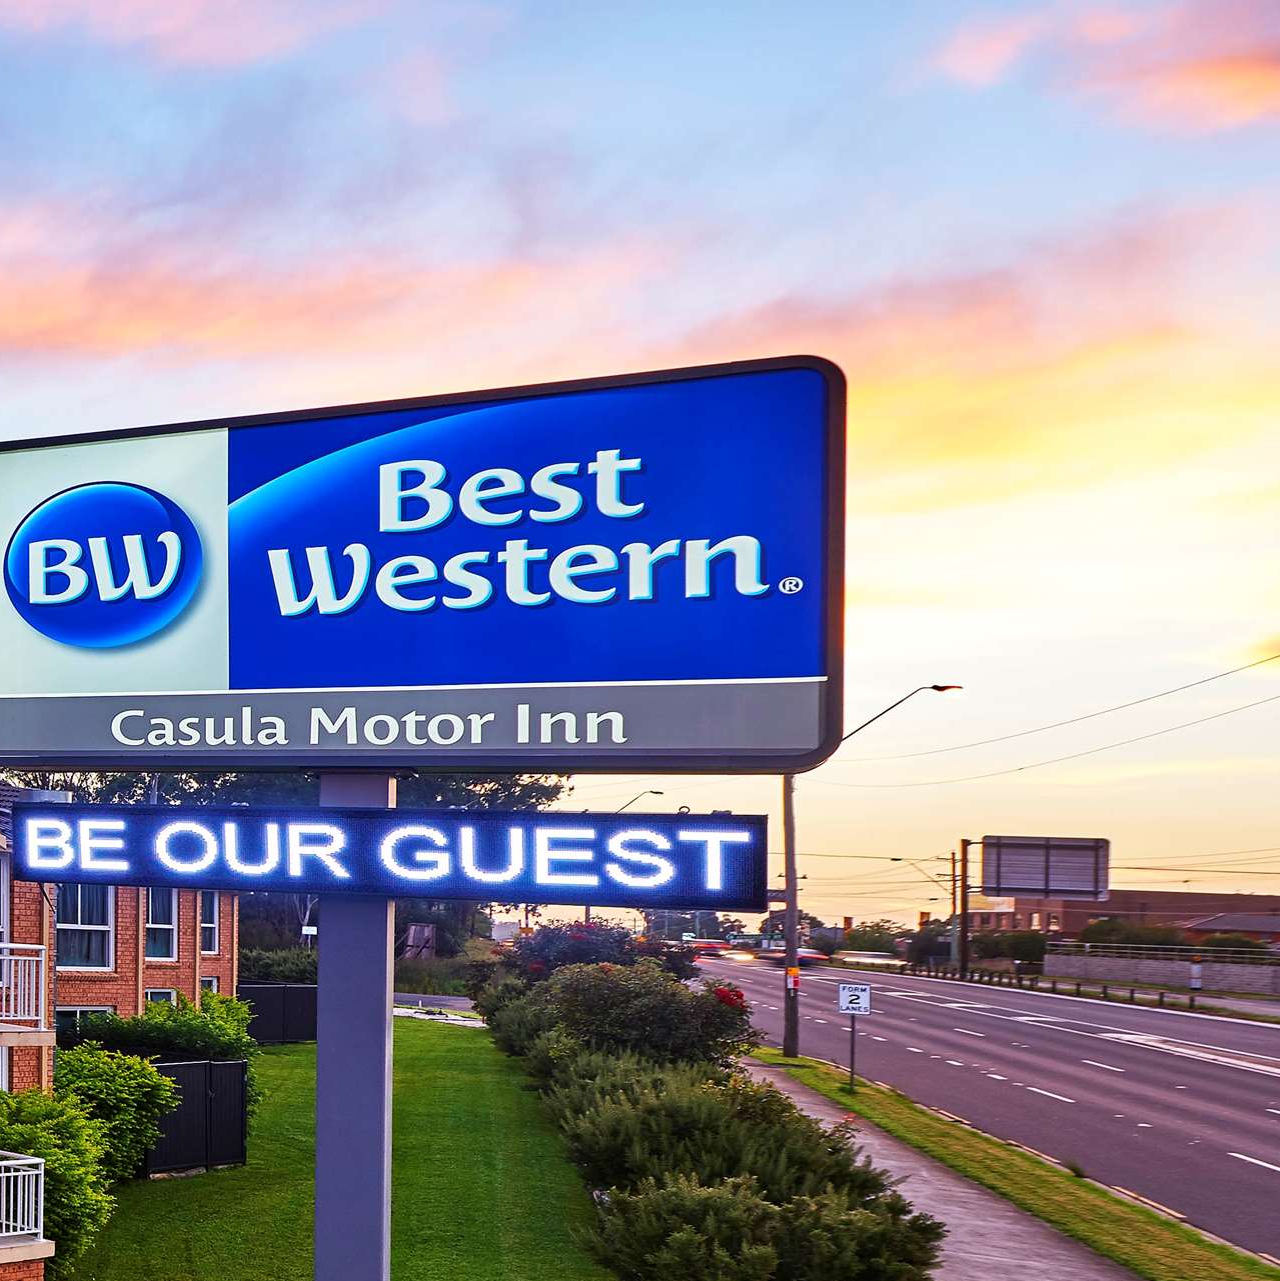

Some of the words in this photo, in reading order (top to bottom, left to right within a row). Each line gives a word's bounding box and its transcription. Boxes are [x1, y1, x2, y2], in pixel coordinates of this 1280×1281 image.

[379, 449, 645, 533] Best
[28, 530, 182, 606] BW
[111, 706, 290, 747] Casula
[309, 707, 496, 746] Motor
[517, 704, 629, 745] Inn
[25, 817, 130, 873] BE
[153, 820, 352, 880] OUR
[379, 824, 752, 891] GUEST
[848, 994, 860, 1004] 2
